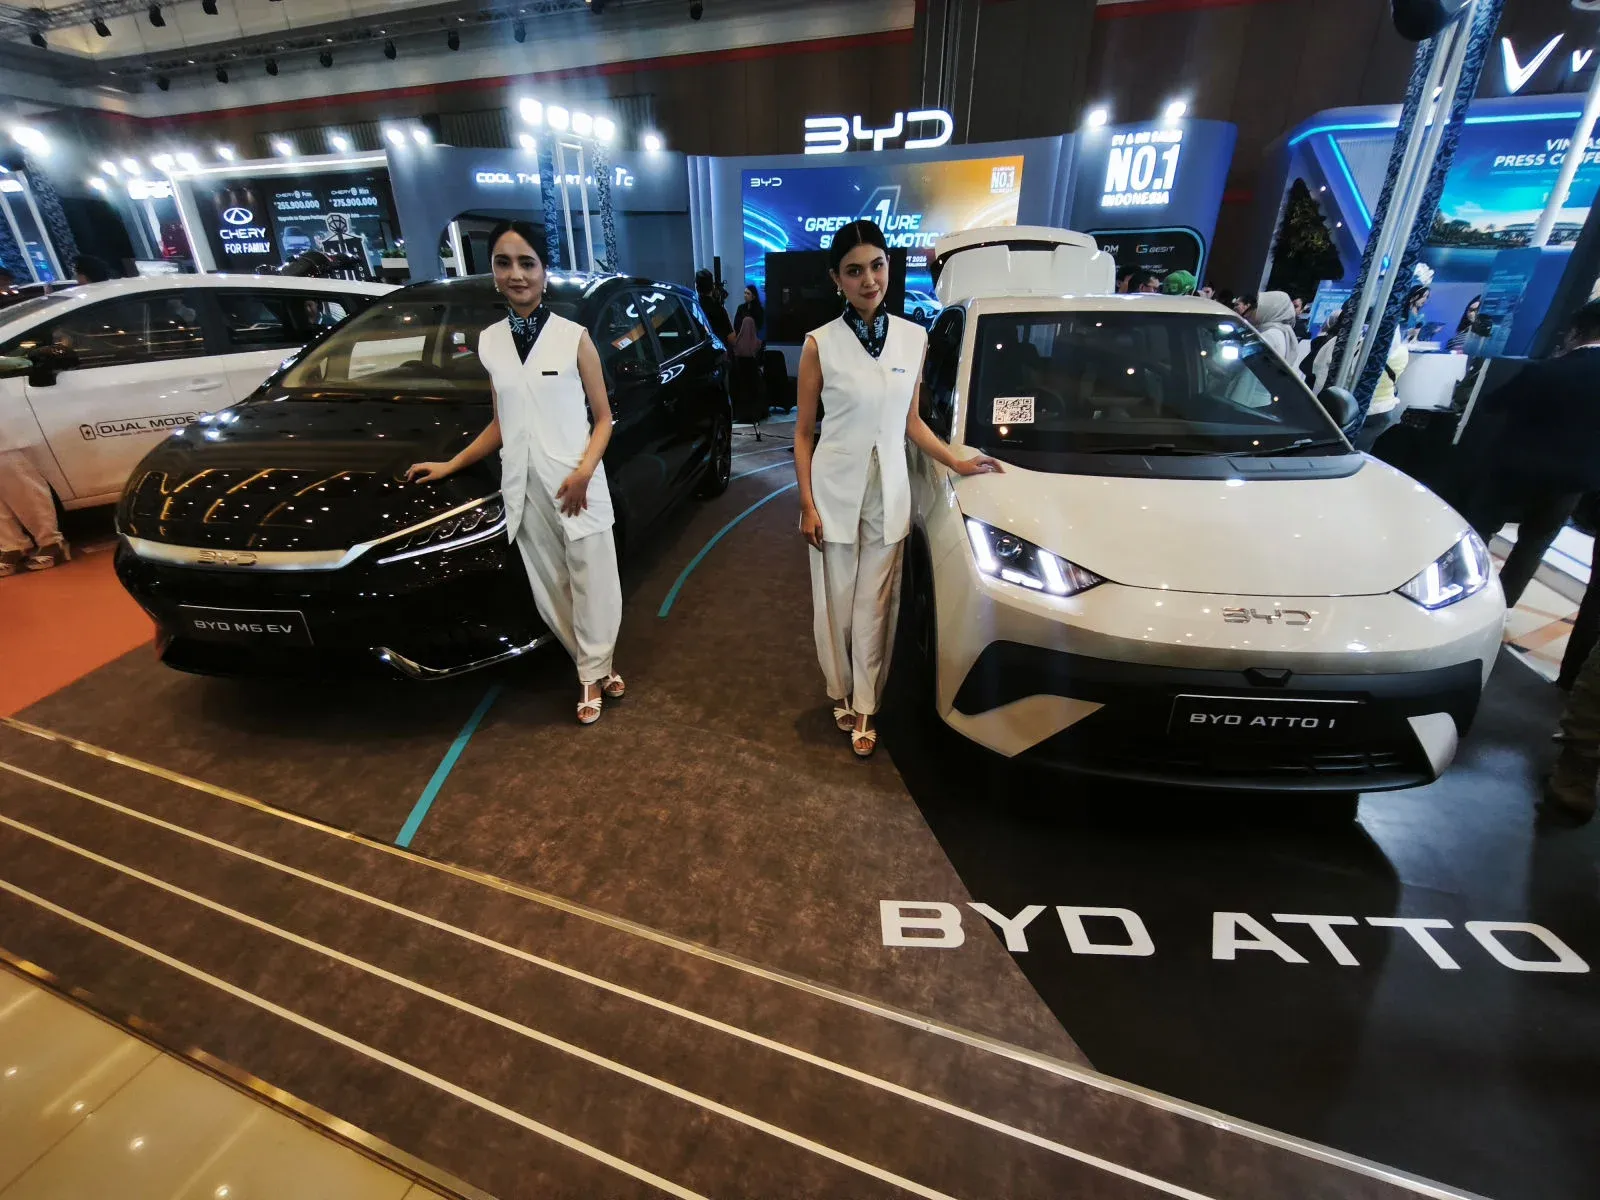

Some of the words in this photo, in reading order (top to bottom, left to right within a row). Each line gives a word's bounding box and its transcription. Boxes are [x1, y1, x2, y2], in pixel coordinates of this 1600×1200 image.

[804, 109, 954, 155] BYD
[1104, 143, 1181, 192] NO.1
[1493, 154, 1547, 167] PRESS
[475, 172, 514, 183] COOL
[750, 177, 783, 187] BYD
[1101, 191, 1169, 206] INDONESIA
[219, 228, 267, 240] CHERY
[224, 243, 242, 254] FOR
[243, 241, 271, 253] FAMILY
[100, 422, 146, 434] DUAL
[149, 415, 197, 428] MODE
[1222, 606, 1312, 626] BYD
[193, 620, 231, 631] BYD
[234, 623, 263, 633] M6
[266, 624, 293, 633] EV
[1189, 713, 1242, 725] BYD
[1249, 716, 1319, 729] ATTO
[879, 900, 1156, 956] BYD
[1212, 911, 1591, 973] ATTO
